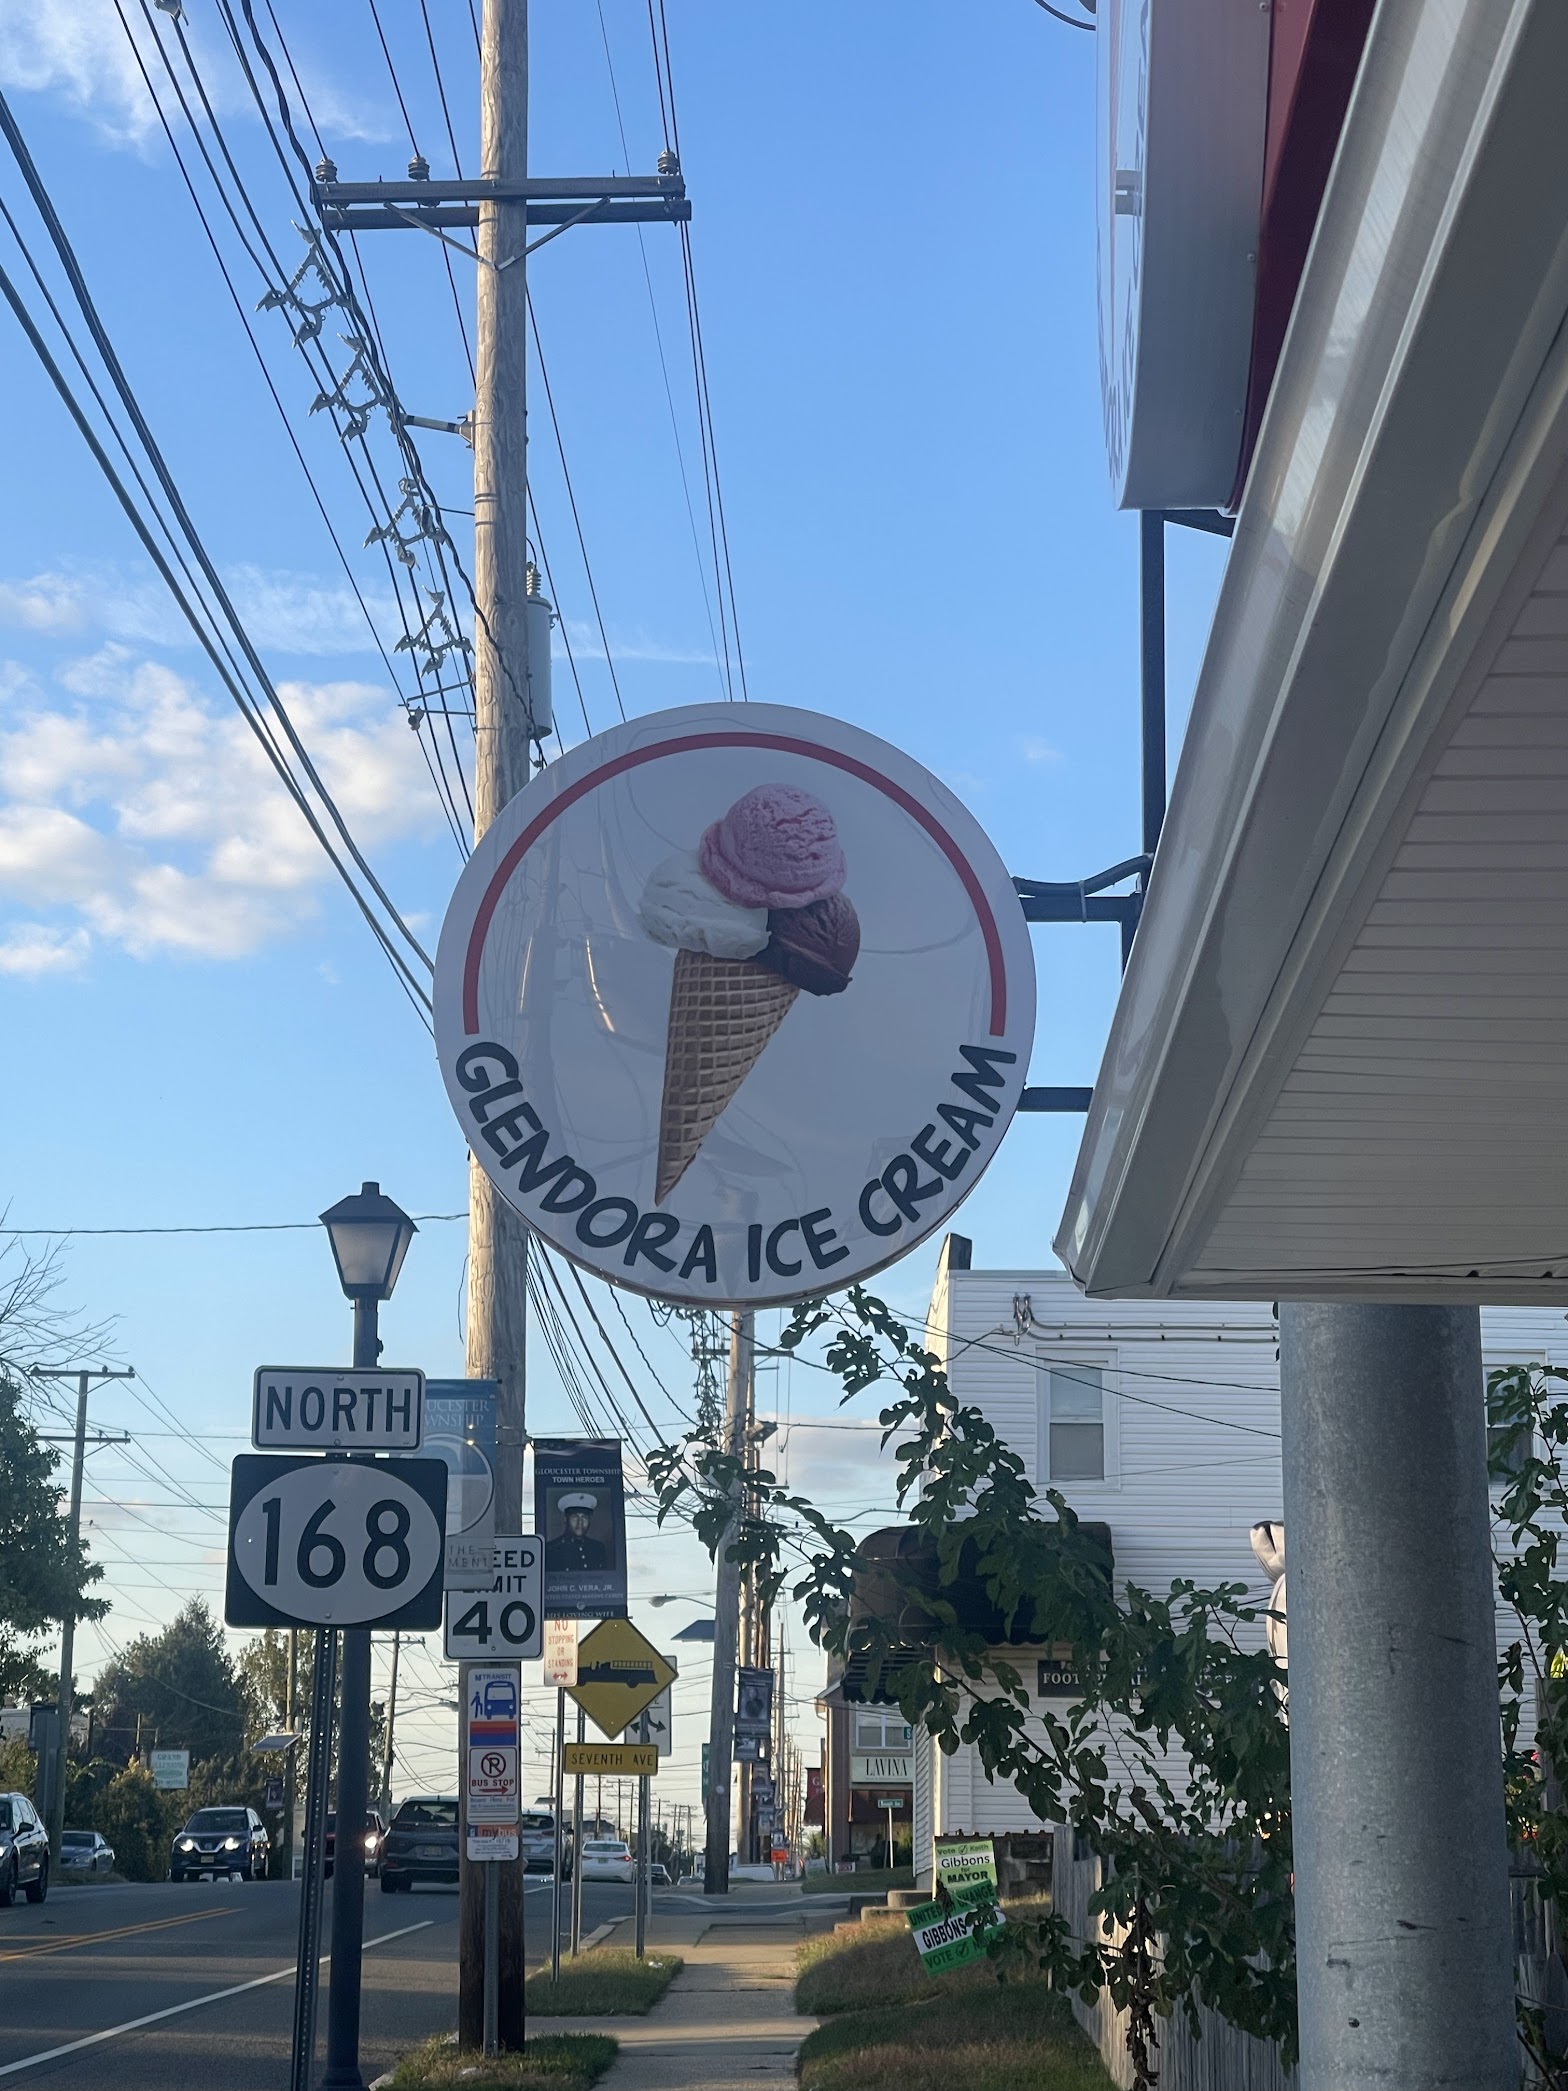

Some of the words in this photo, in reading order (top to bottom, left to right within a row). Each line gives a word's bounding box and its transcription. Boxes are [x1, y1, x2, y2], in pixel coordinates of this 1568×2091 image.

[456, 1041, 717, 1283] GLENDORA
[748, 1207, 850, 1283] ICE
[859, 1044, 1017, 1237] CREAM
[265, 1386, 411, 1432] NORTH
[425, 1400, 490, 1412] UCESTER
[424, 1413, 484, 1427] WNSHIP
[262, 1497, 411, 1590] 168
[493, 1550, 535, 1568] EED
[480, 1575, 527, 1593] MIT
[578, 1584, 601, 1592] VERA,
[452, 1600, 536, 1645] 40
[554, 1620, 569, 1631] NO
[548, 1634, 574, 1645] STOPPING
[557, 1646, 565, 1657] OR
[548, 1658, 574, 1669] STANDING
[1043, 1672, 1080, 1685] FOOT
[571, 1753, 623, 1766] SEVENTH
[633, 1753, 653, 1766] AVE
[866, 1758, 908, 1776] LAVINA
[471, 1779, 489, 1787] BUS
[493, 1779, 515, 1787] STOP
[937, 1848, 956, 1856] Vote
[969, 1843, 989, 1852] Keith
[941, 1854, 990, 1869] Gibbons
[947, 1870, 989, 1883] MAYOR
[922, 1917, 968, 1949] GIBBONS
[924, 1950, 954, 1969] VOTE
